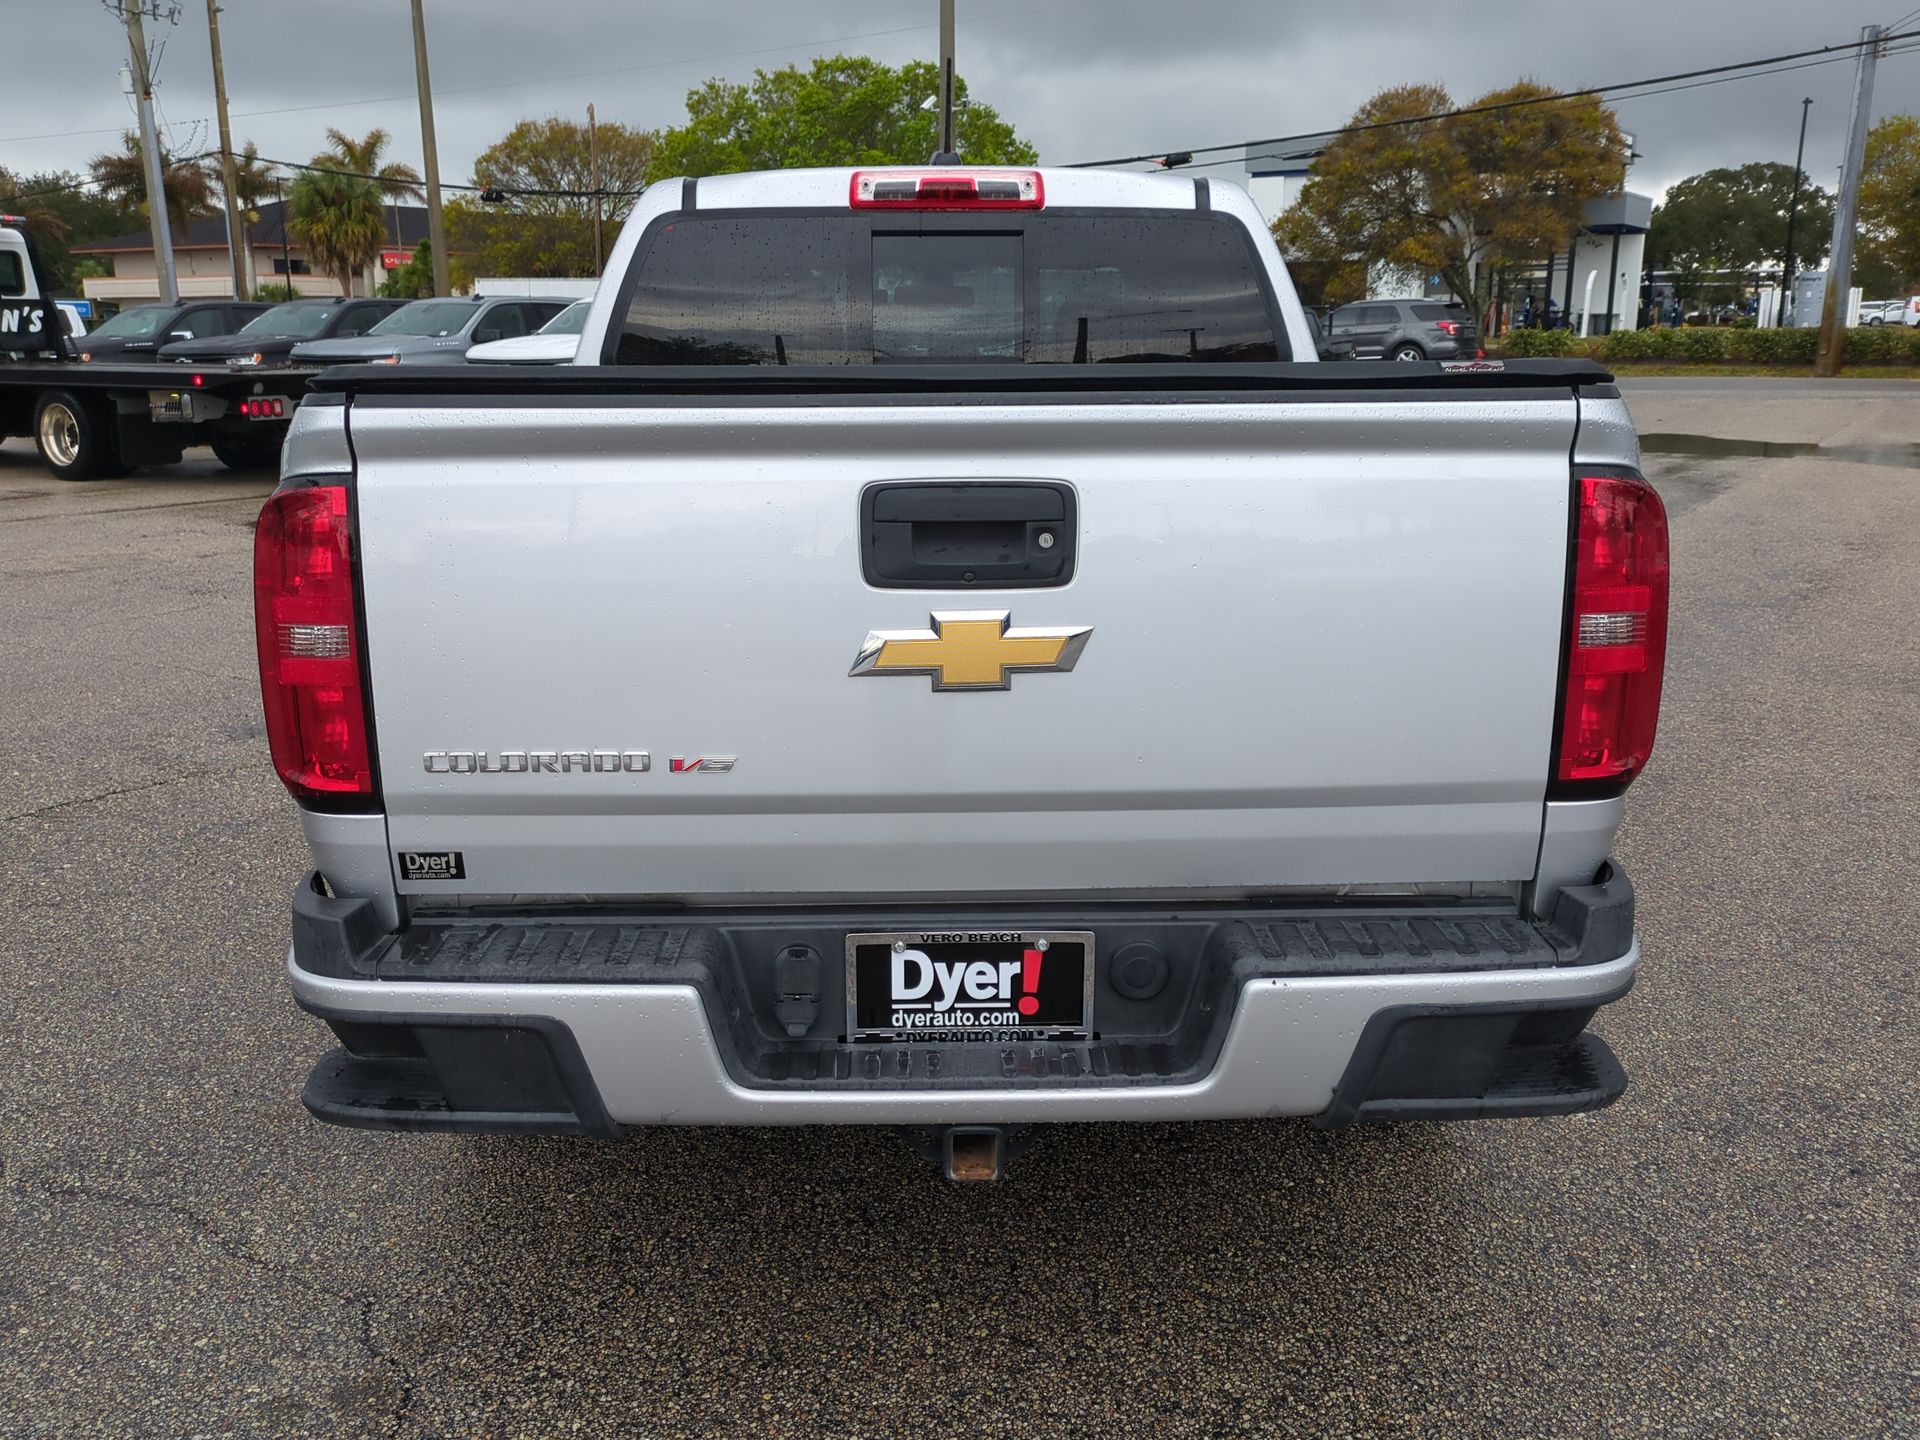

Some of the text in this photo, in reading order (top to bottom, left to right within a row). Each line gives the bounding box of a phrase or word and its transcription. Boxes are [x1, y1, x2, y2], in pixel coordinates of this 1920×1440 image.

[423, 750, 738, 774] COLORADO V6
[405, 853, 457, 874] Dyer!
[408, 872, 451, 880] dyerauto.com
[920, 932, 1022, 943] VERO BEACH
[891, 949, 1044, 1015] Dyer!
[892, 1009, 1020, 1028] dyerauto.com
